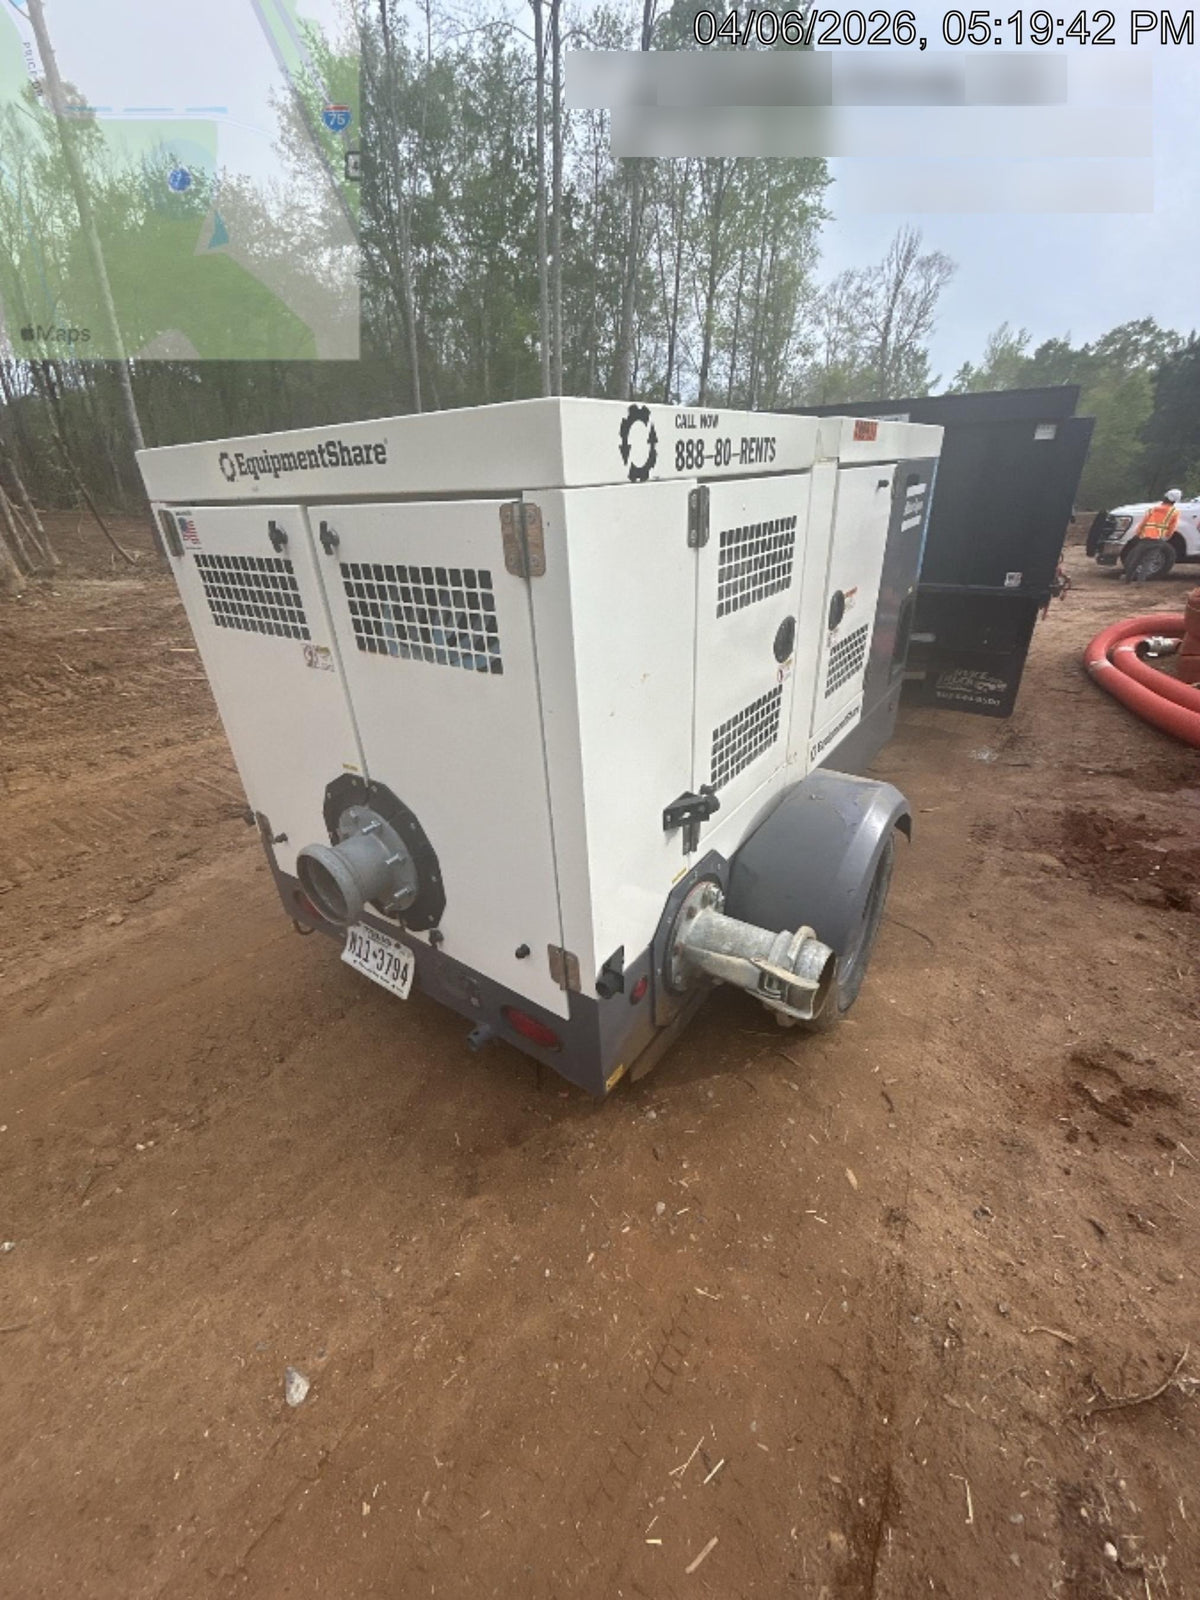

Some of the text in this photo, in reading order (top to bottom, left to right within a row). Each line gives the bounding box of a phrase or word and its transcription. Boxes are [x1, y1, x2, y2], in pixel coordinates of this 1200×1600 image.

[675, 413, 720, 430] CALL NOW
[233, 439, 388, 481] EquipmentShare
[674, 436, 777, 472] 888-80-RENTS
